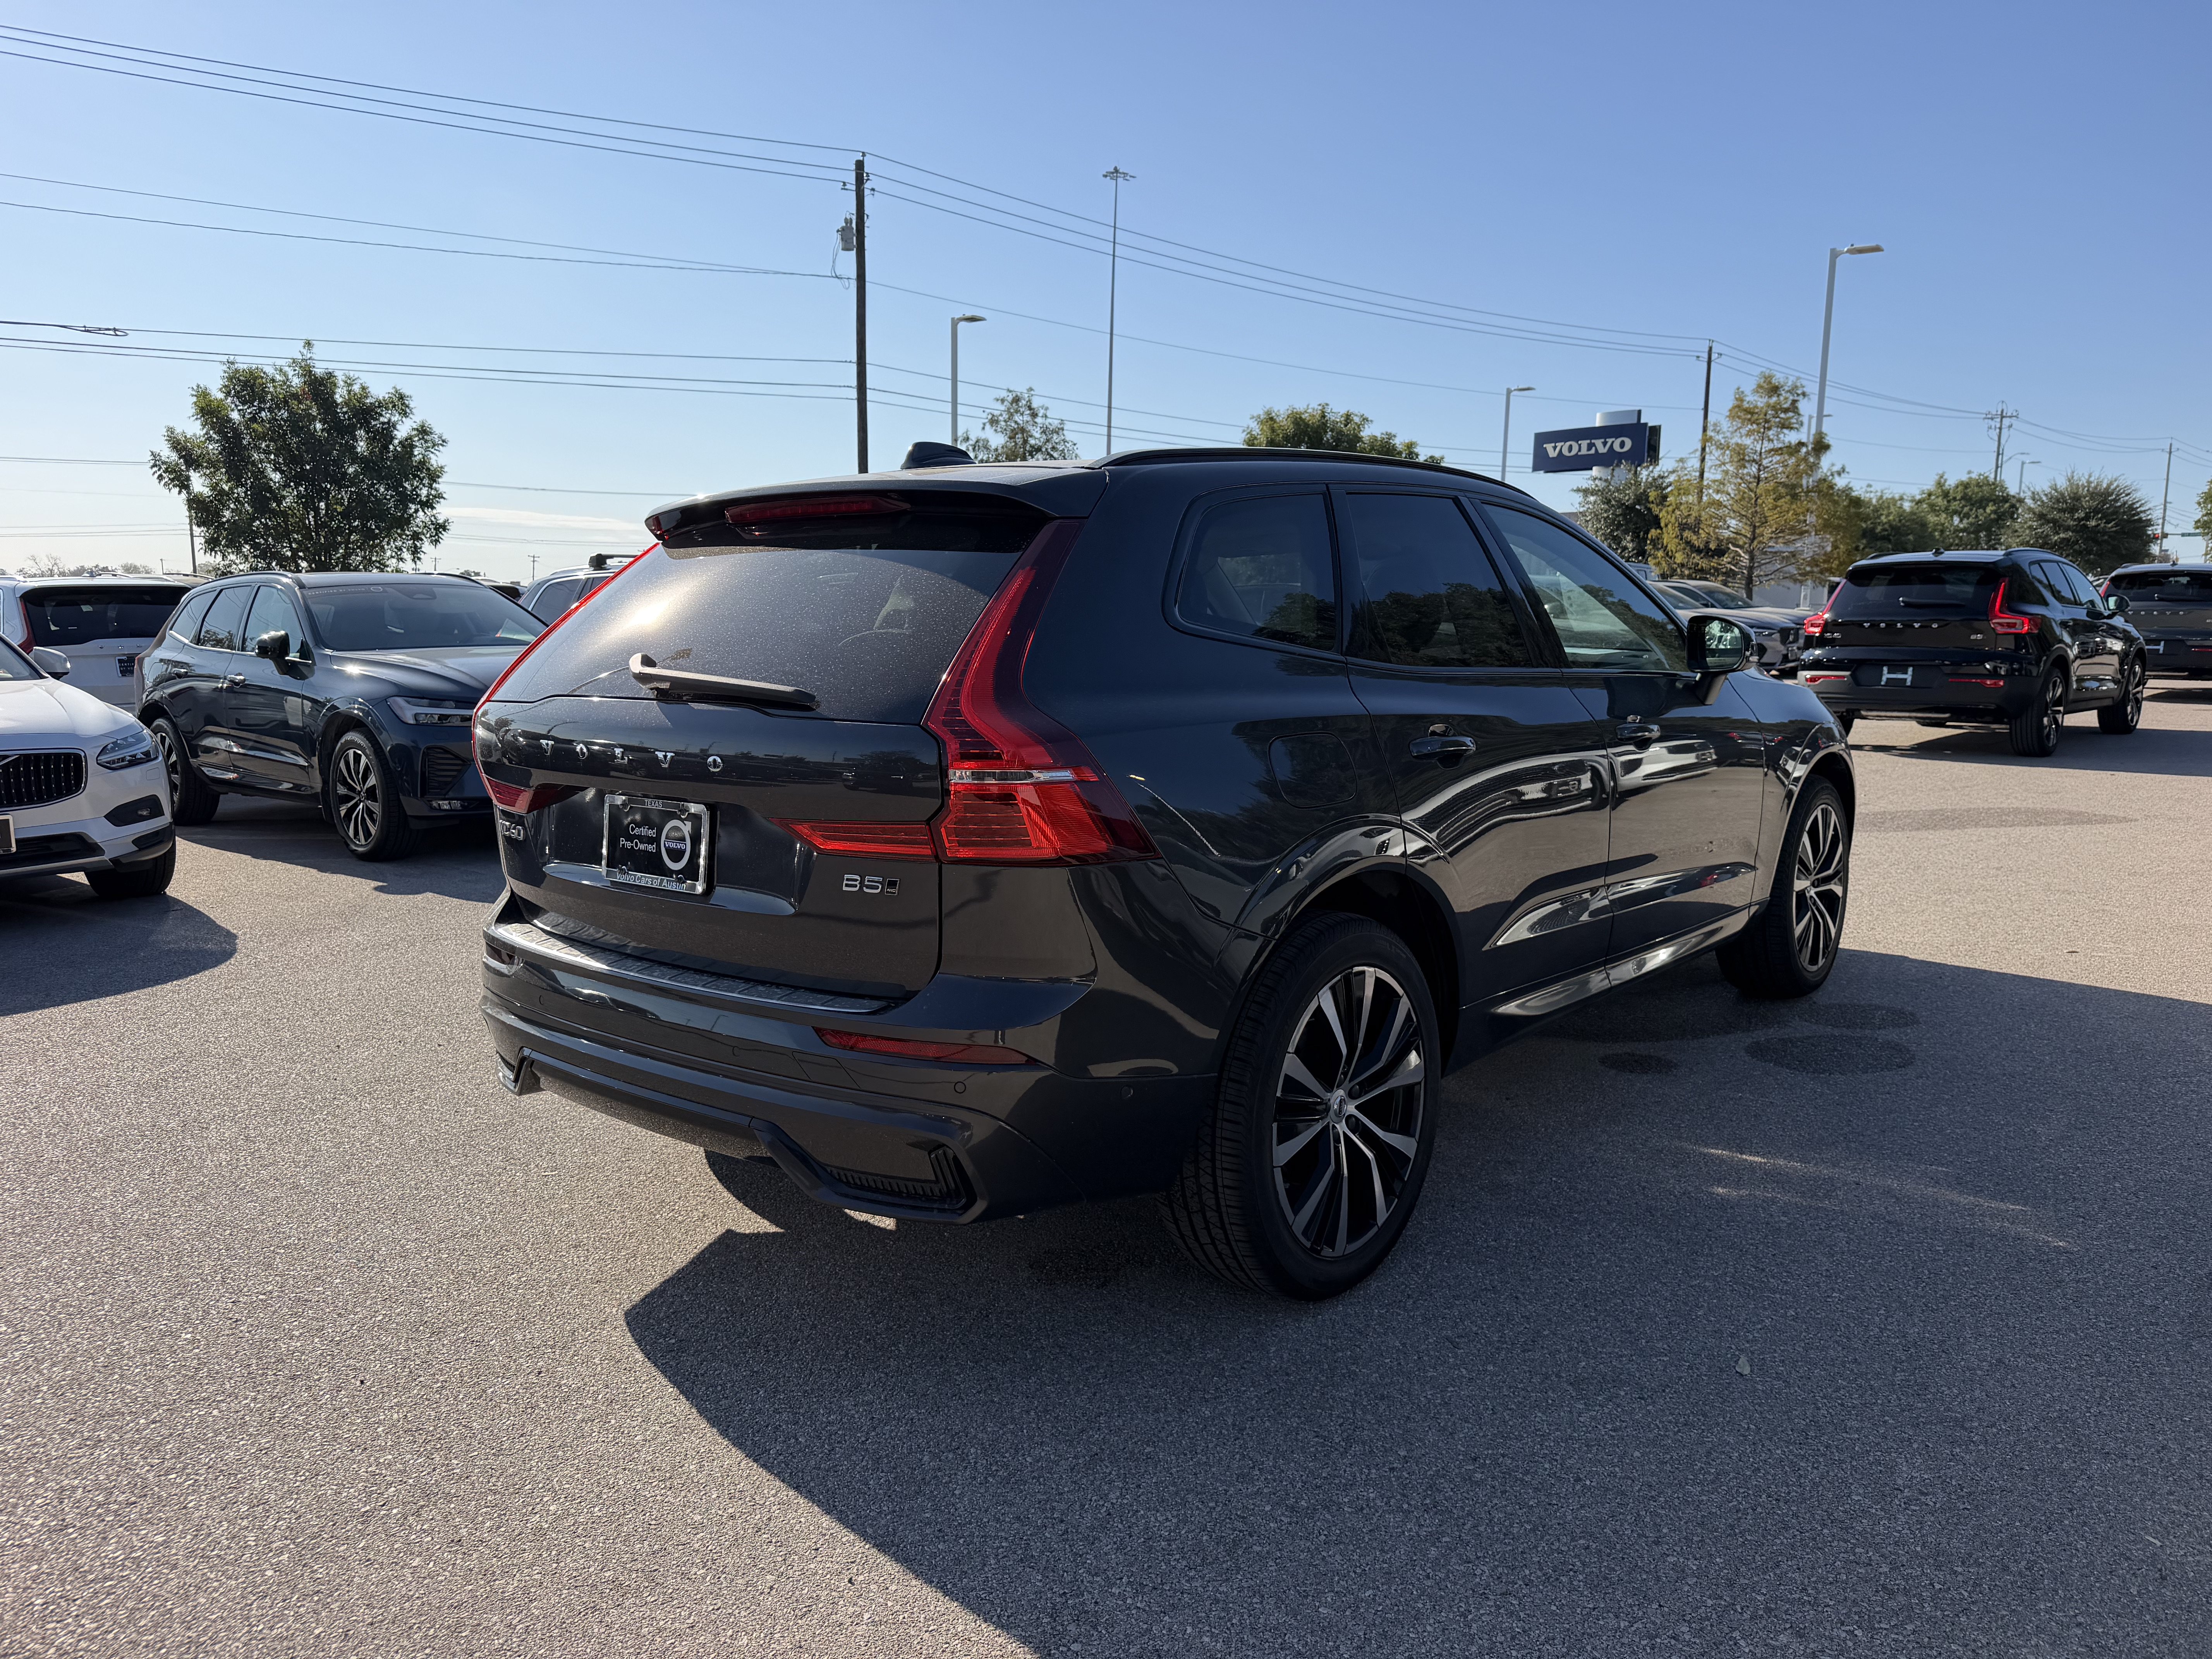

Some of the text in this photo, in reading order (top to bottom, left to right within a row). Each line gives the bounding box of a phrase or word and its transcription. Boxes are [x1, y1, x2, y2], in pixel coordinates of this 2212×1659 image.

[1543, 436, 1632, 458] VOLVO
[540, 740, 724, 772] VOLVO
[644, 799, 663, 808] TEXAS
[629, 824, 656, 837] Certified
[620, 838, 656, 852] Pre-Owned
[664, 841, 686, 850] VOLVO
[616, 872, 634, 882] Volvo
[635, 875, 652, 885] Cars
[662, 878, 686, 890] Austin
[843, 874, 883, 893] B5
